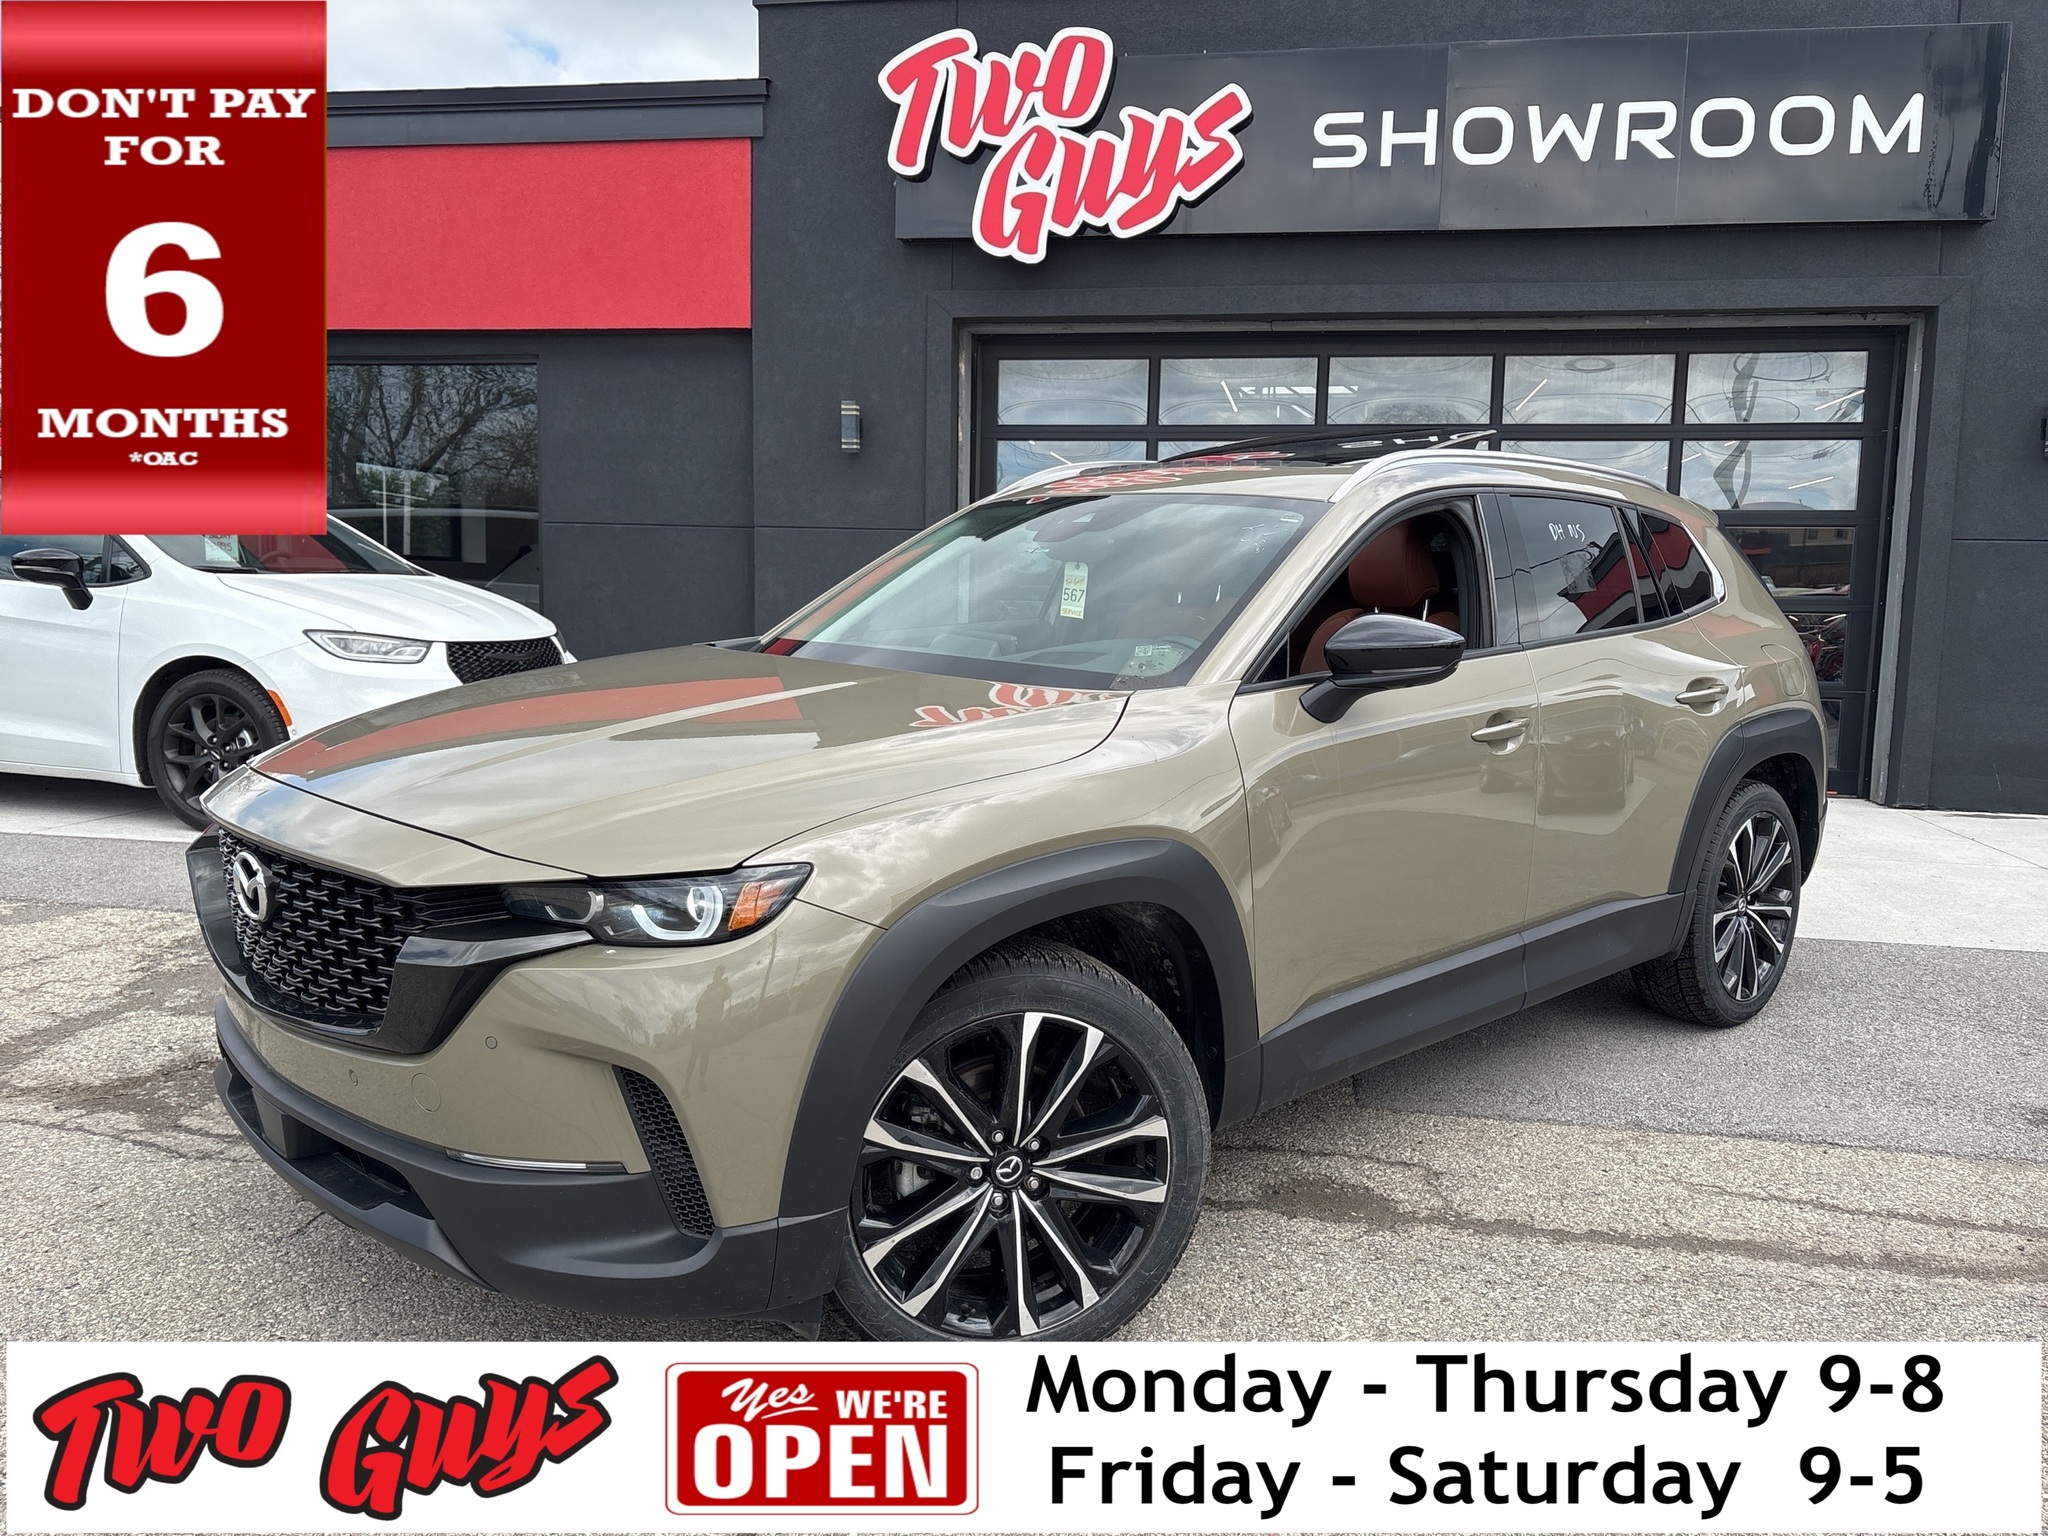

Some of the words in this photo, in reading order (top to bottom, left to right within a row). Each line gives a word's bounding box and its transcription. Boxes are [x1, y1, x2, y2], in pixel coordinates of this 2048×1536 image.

[878, 27, 1114, 176] Two
[1313, 93, 1924, 169] SHOWROOM
[971, 83, 1253, 264] Guys
[1063, 588, 1085, 602] 567
